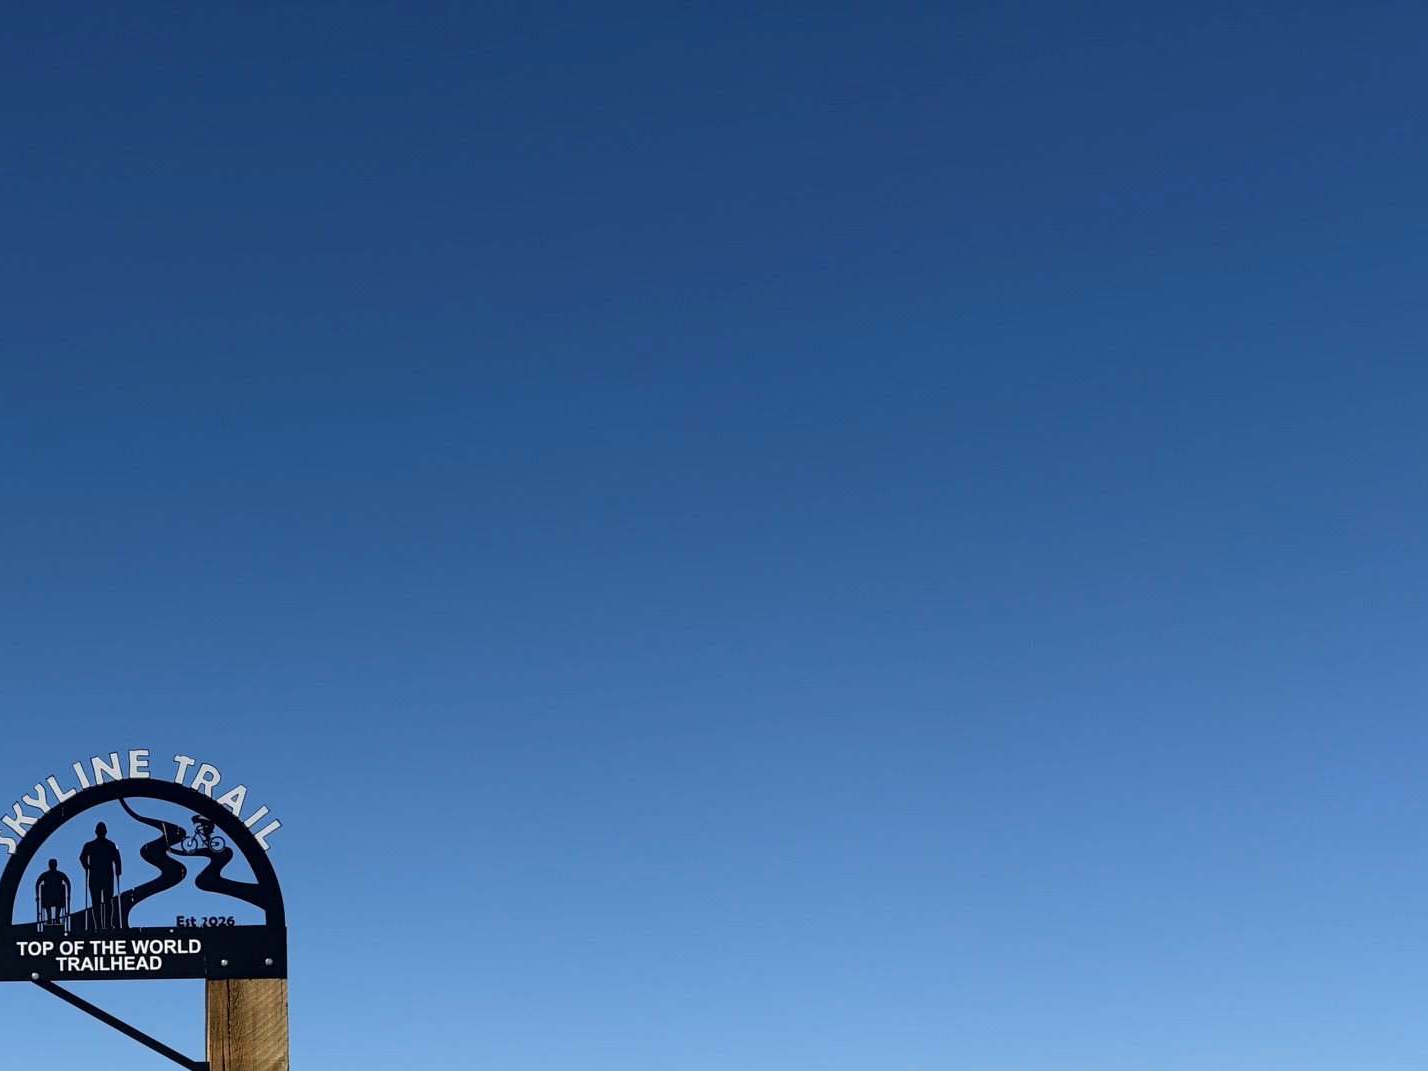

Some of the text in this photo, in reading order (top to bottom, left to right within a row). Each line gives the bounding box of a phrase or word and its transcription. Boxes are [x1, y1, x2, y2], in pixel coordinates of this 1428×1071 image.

[172, 755, 282, 850] TRAIL
[17, 939, 201, 956] TOP OF THE WORLD
[56, 956, 162, 971] TRAILHEAD
